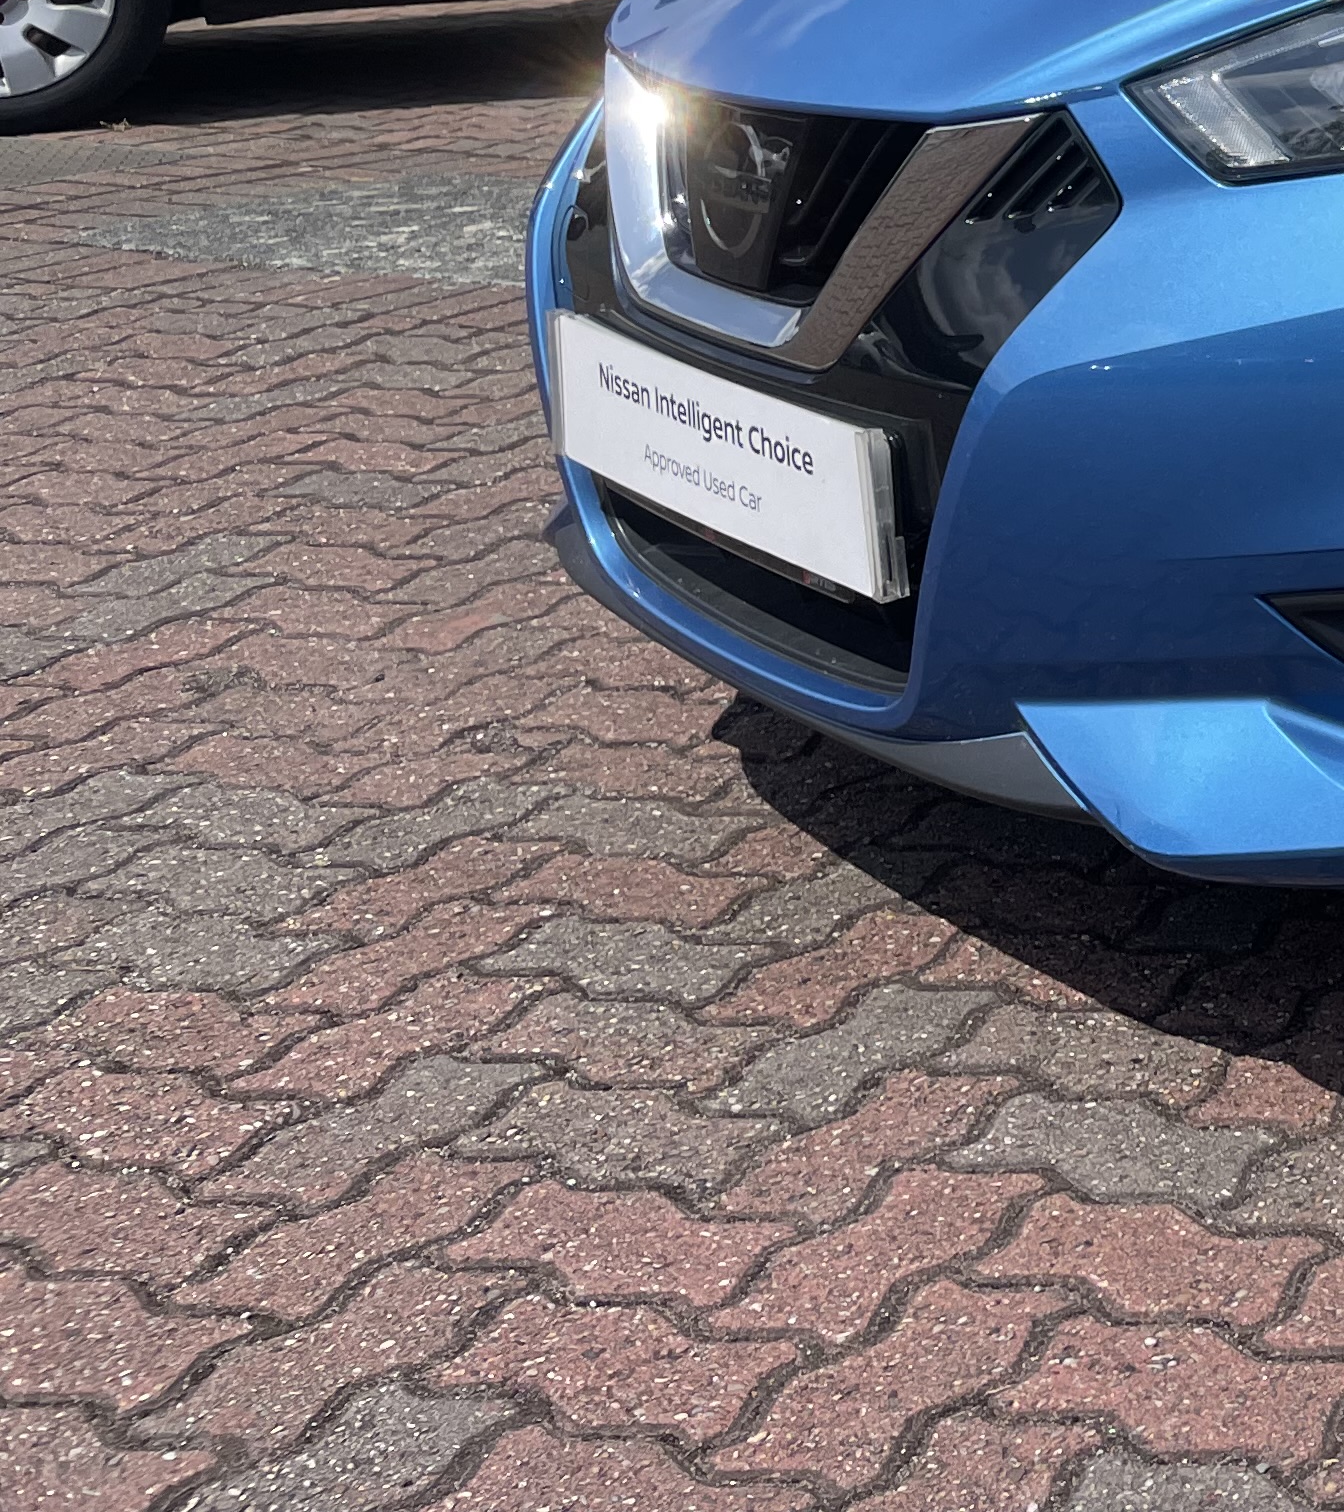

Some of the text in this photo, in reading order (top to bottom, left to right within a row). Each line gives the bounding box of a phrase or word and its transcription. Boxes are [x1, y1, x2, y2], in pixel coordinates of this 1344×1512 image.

[598, 361, 815, 475] Nissan Intelligent Choice
[644, 443, 763, 513] Approved Used Car
